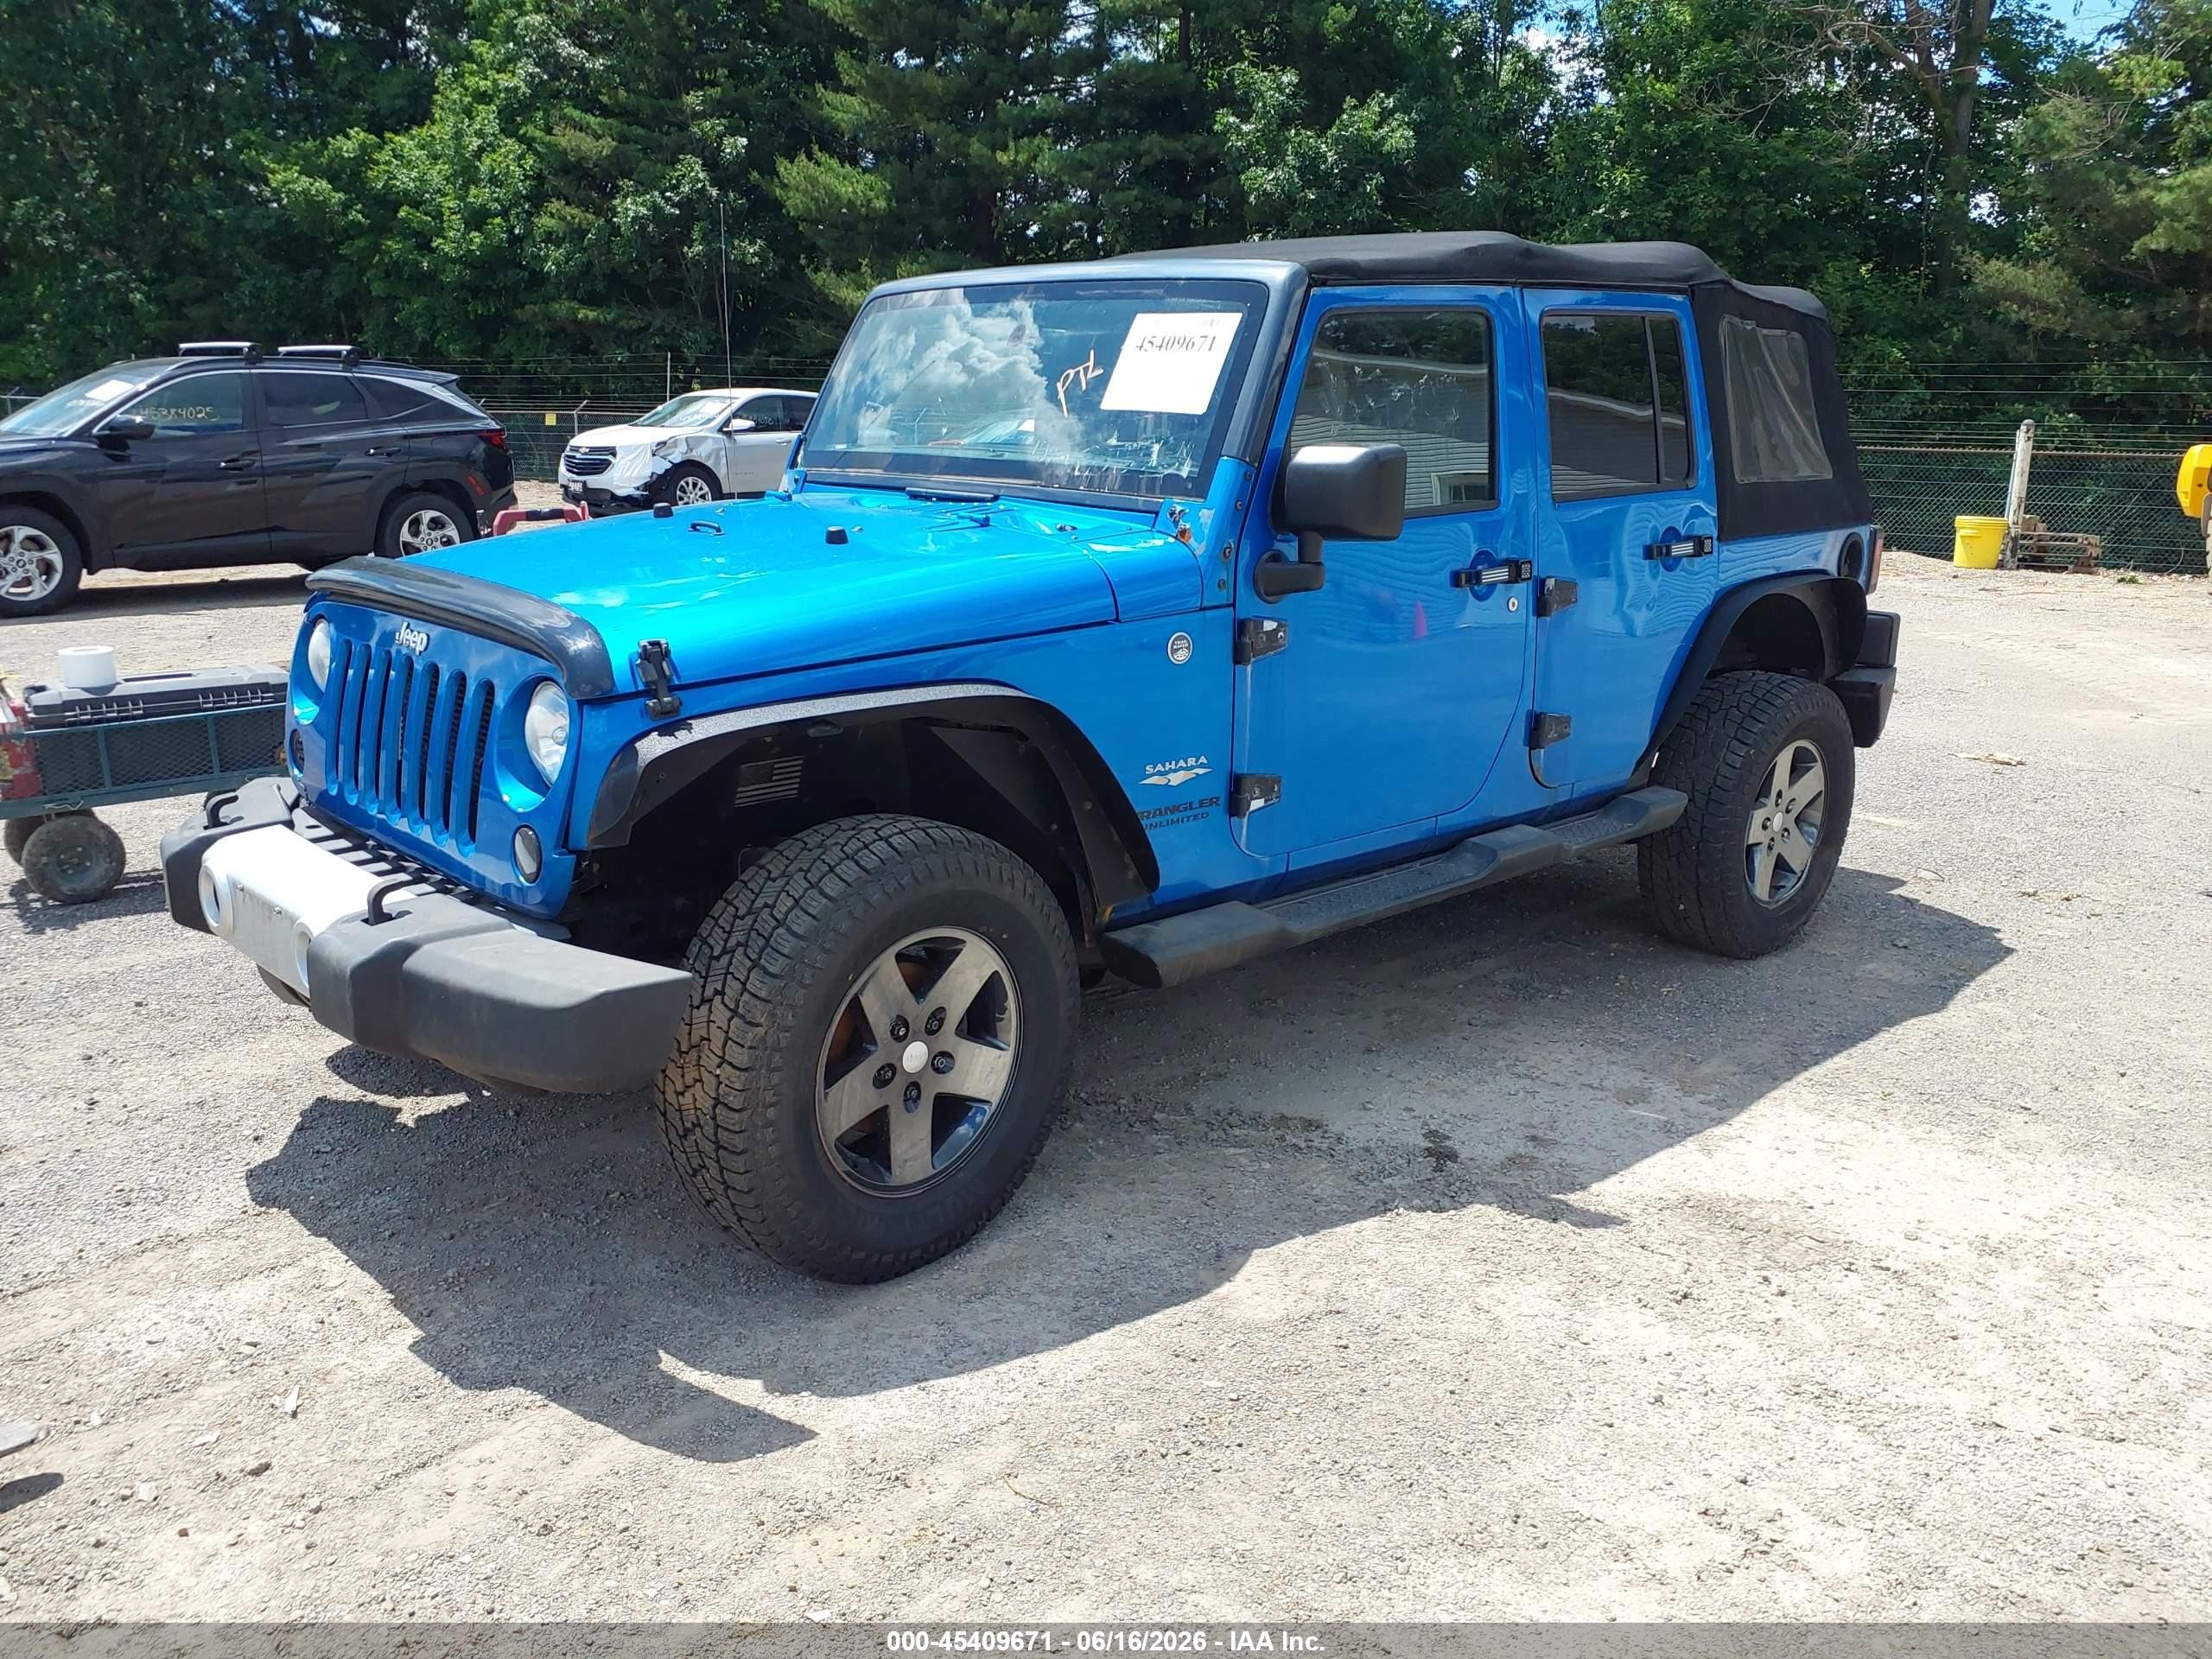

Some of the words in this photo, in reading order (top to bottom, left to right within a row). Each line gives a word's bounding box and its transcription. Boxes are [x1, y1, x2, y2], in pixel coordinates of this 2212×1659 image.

[1135, 334, 1217, 353] 45409671
[395, 621, 429, 656] Jeep
[1145, 755, 1208, 774] SAHARA
[1138, 796, 1221, 821] RANGLER
